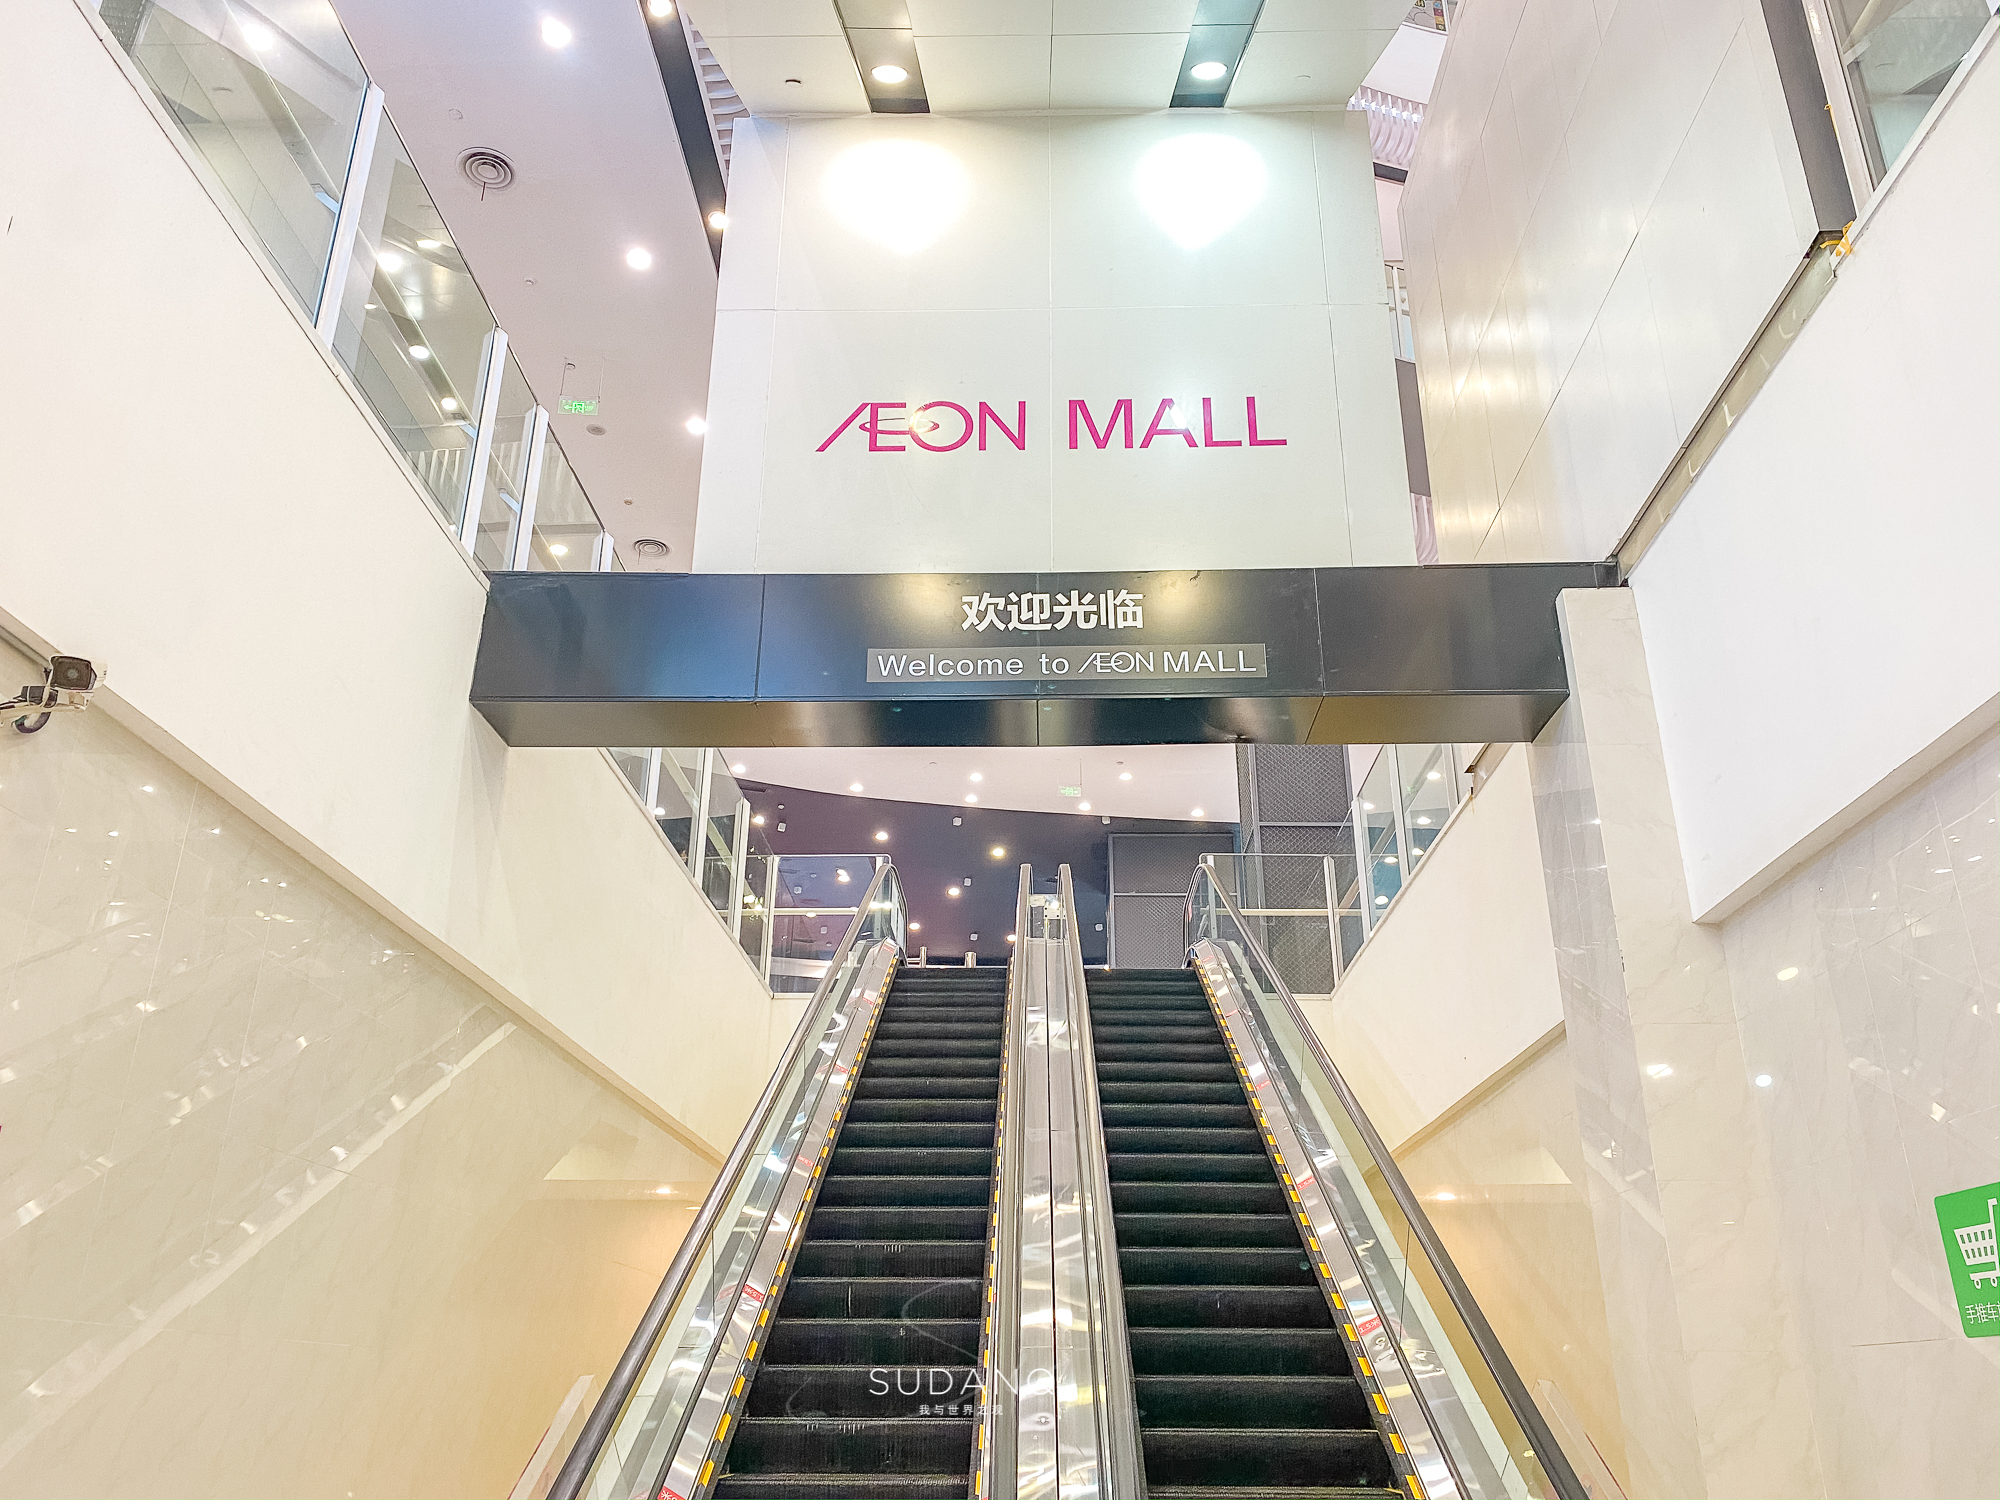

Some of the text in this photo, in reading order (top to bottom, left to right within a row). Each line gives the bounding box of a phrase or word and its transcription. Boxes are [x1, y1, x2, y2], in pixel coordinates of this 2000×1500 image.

[1068, 396, 1288, 450] MALL
[961, 589, 1144, 632] 欢迎光临
[877, 653, 1024, 677] Welcome
[1039, 653, 1069, 675] to
[1163, 650, 1257, 673] MALL
[1965, 1301, 2000, 1324] 手推车
